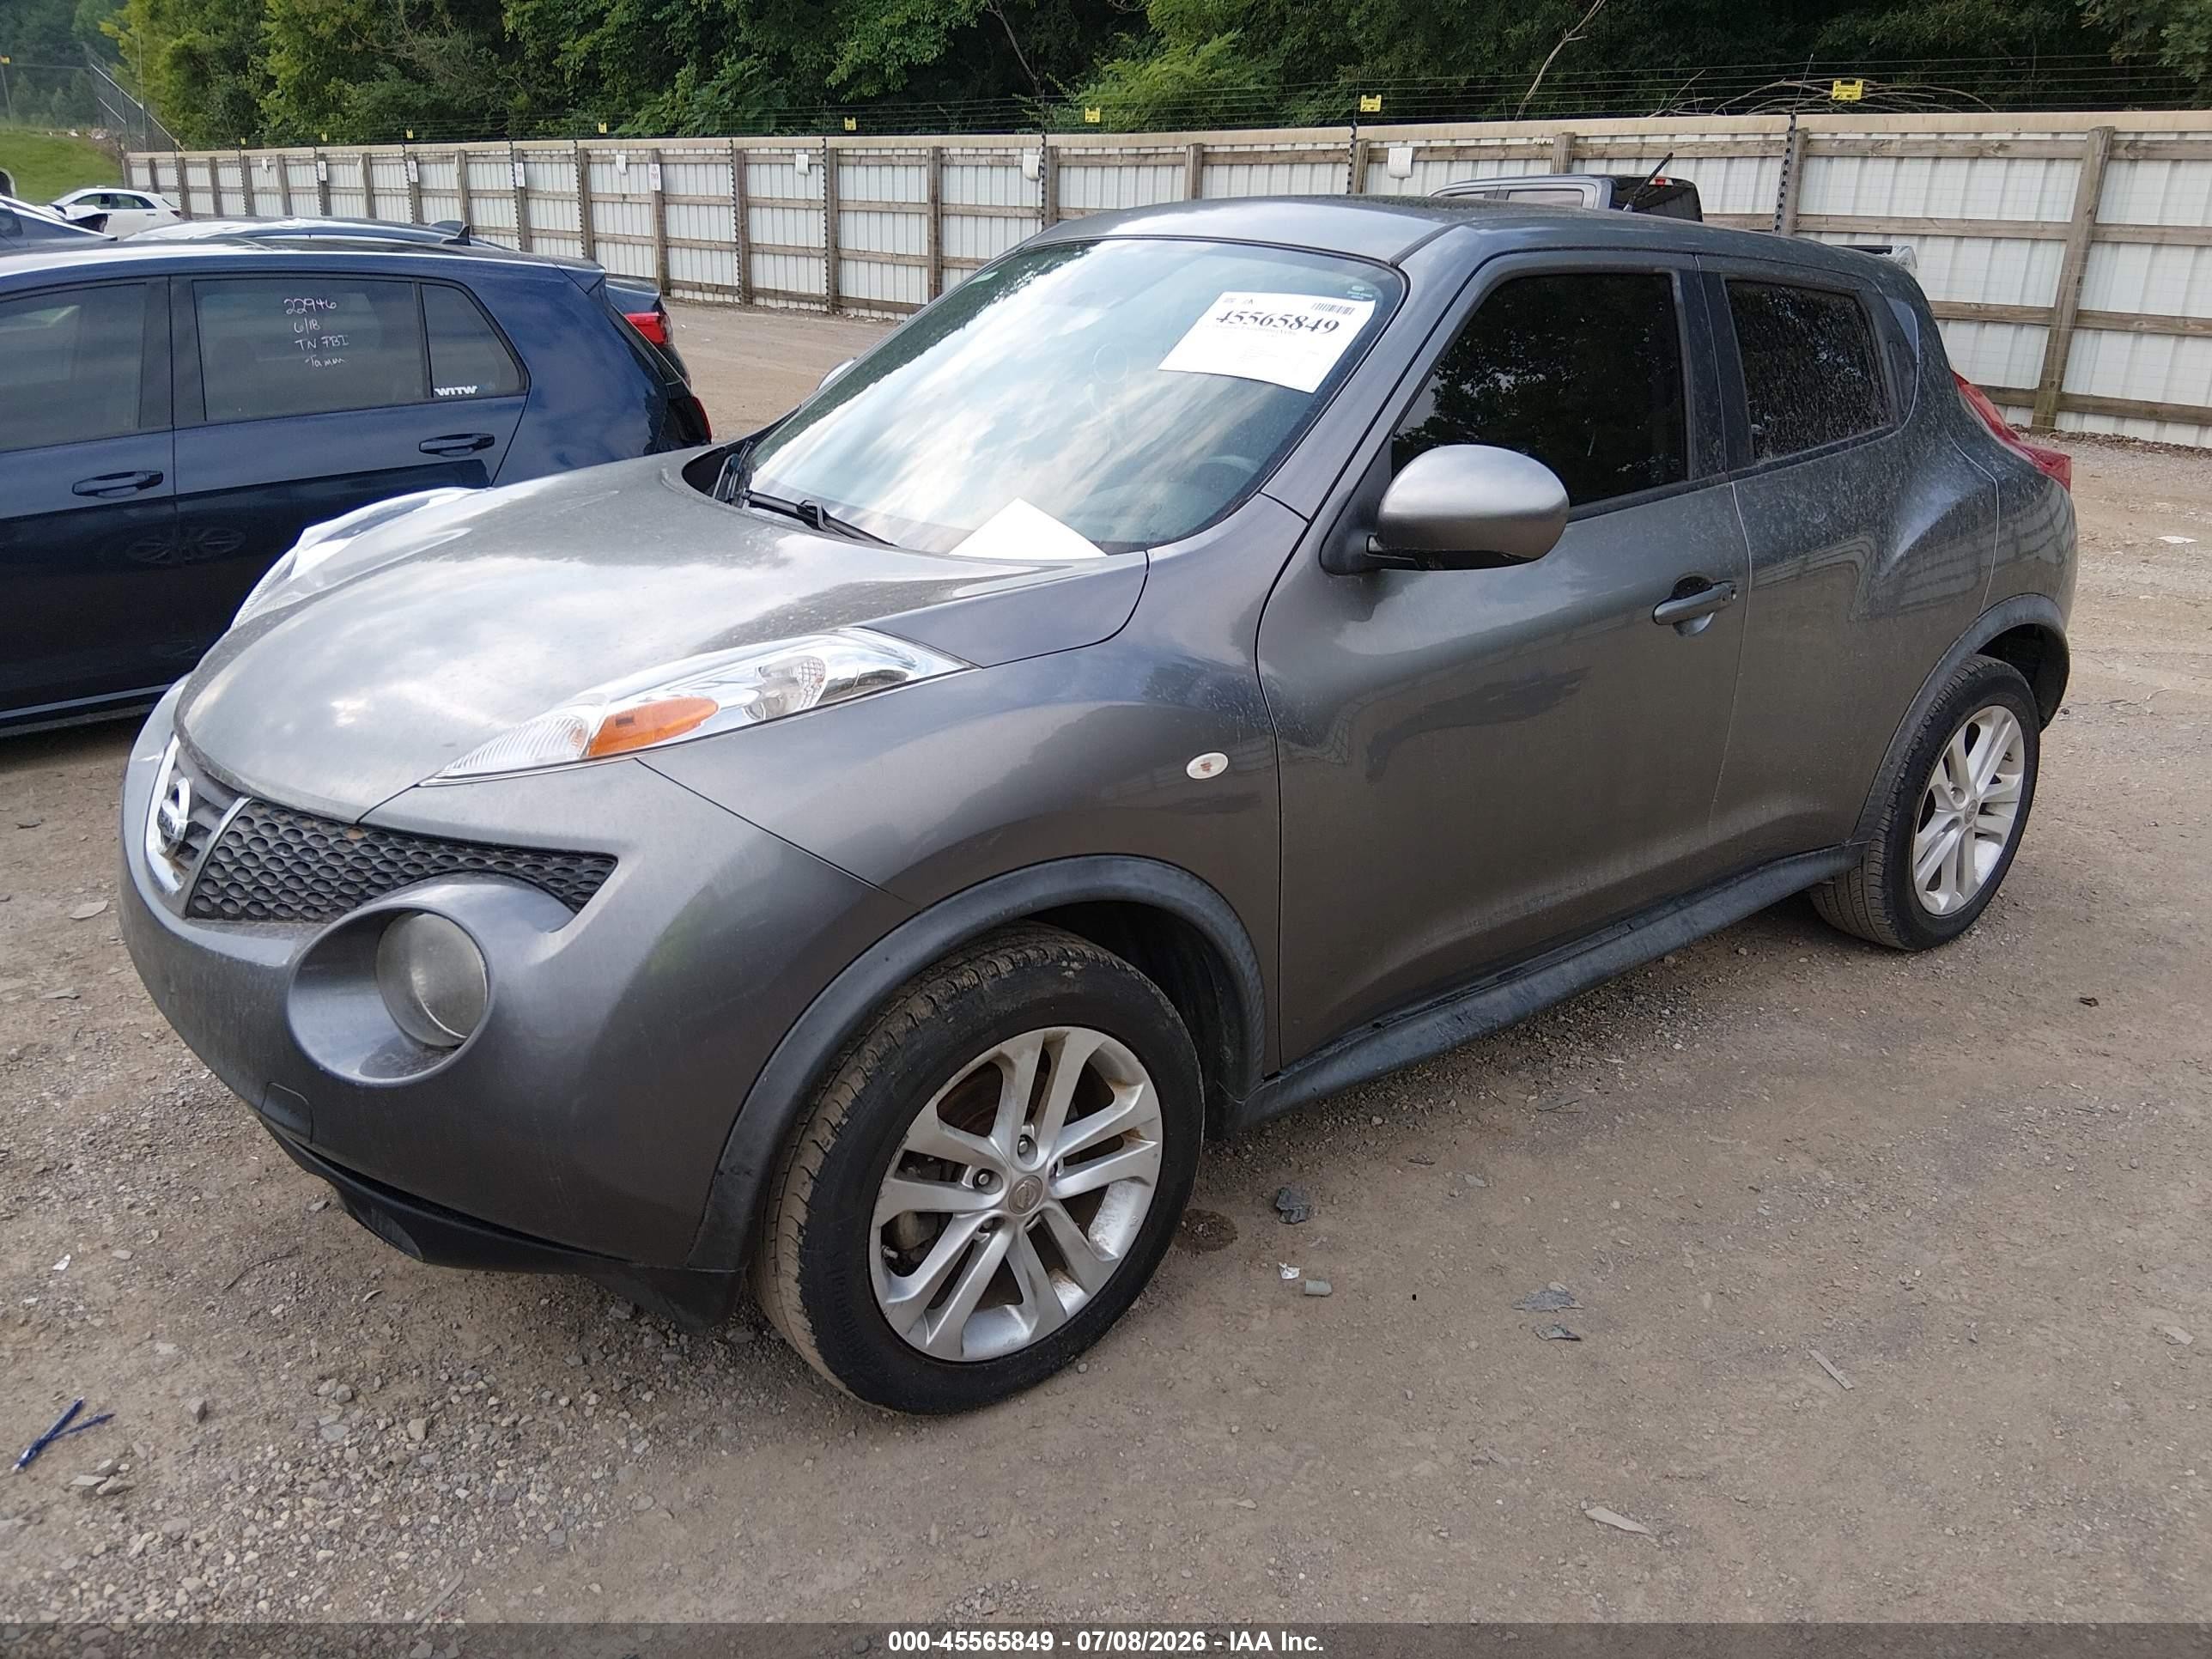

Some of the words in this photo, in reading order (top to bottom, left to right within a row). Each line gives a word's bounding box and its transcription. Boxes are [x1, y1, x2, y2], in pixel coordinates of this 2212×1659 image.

[284, 297, 337, 315] 22946
[1215, 310, 1340, 335] 45565849
[295, 337, 317, 350] TN
